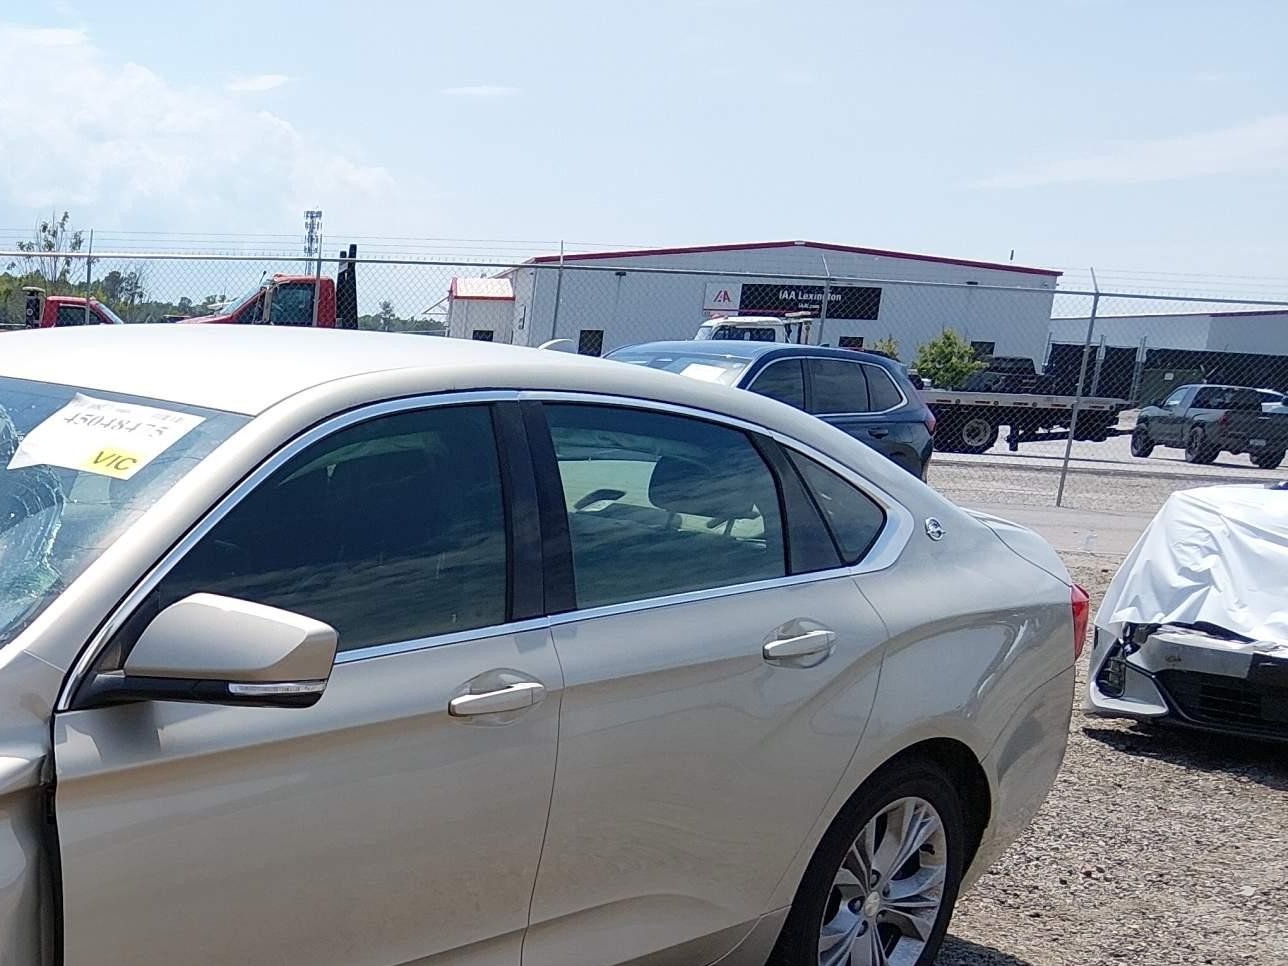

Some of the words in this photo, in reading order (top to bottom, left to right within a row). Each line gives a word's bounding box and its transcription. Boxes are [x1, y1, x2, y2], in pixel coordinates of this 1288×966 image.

[779, 289, 796, 300] IAA
[797, 289, 842, 302] Lexinton
[92, 450, 138, 472] VIC
